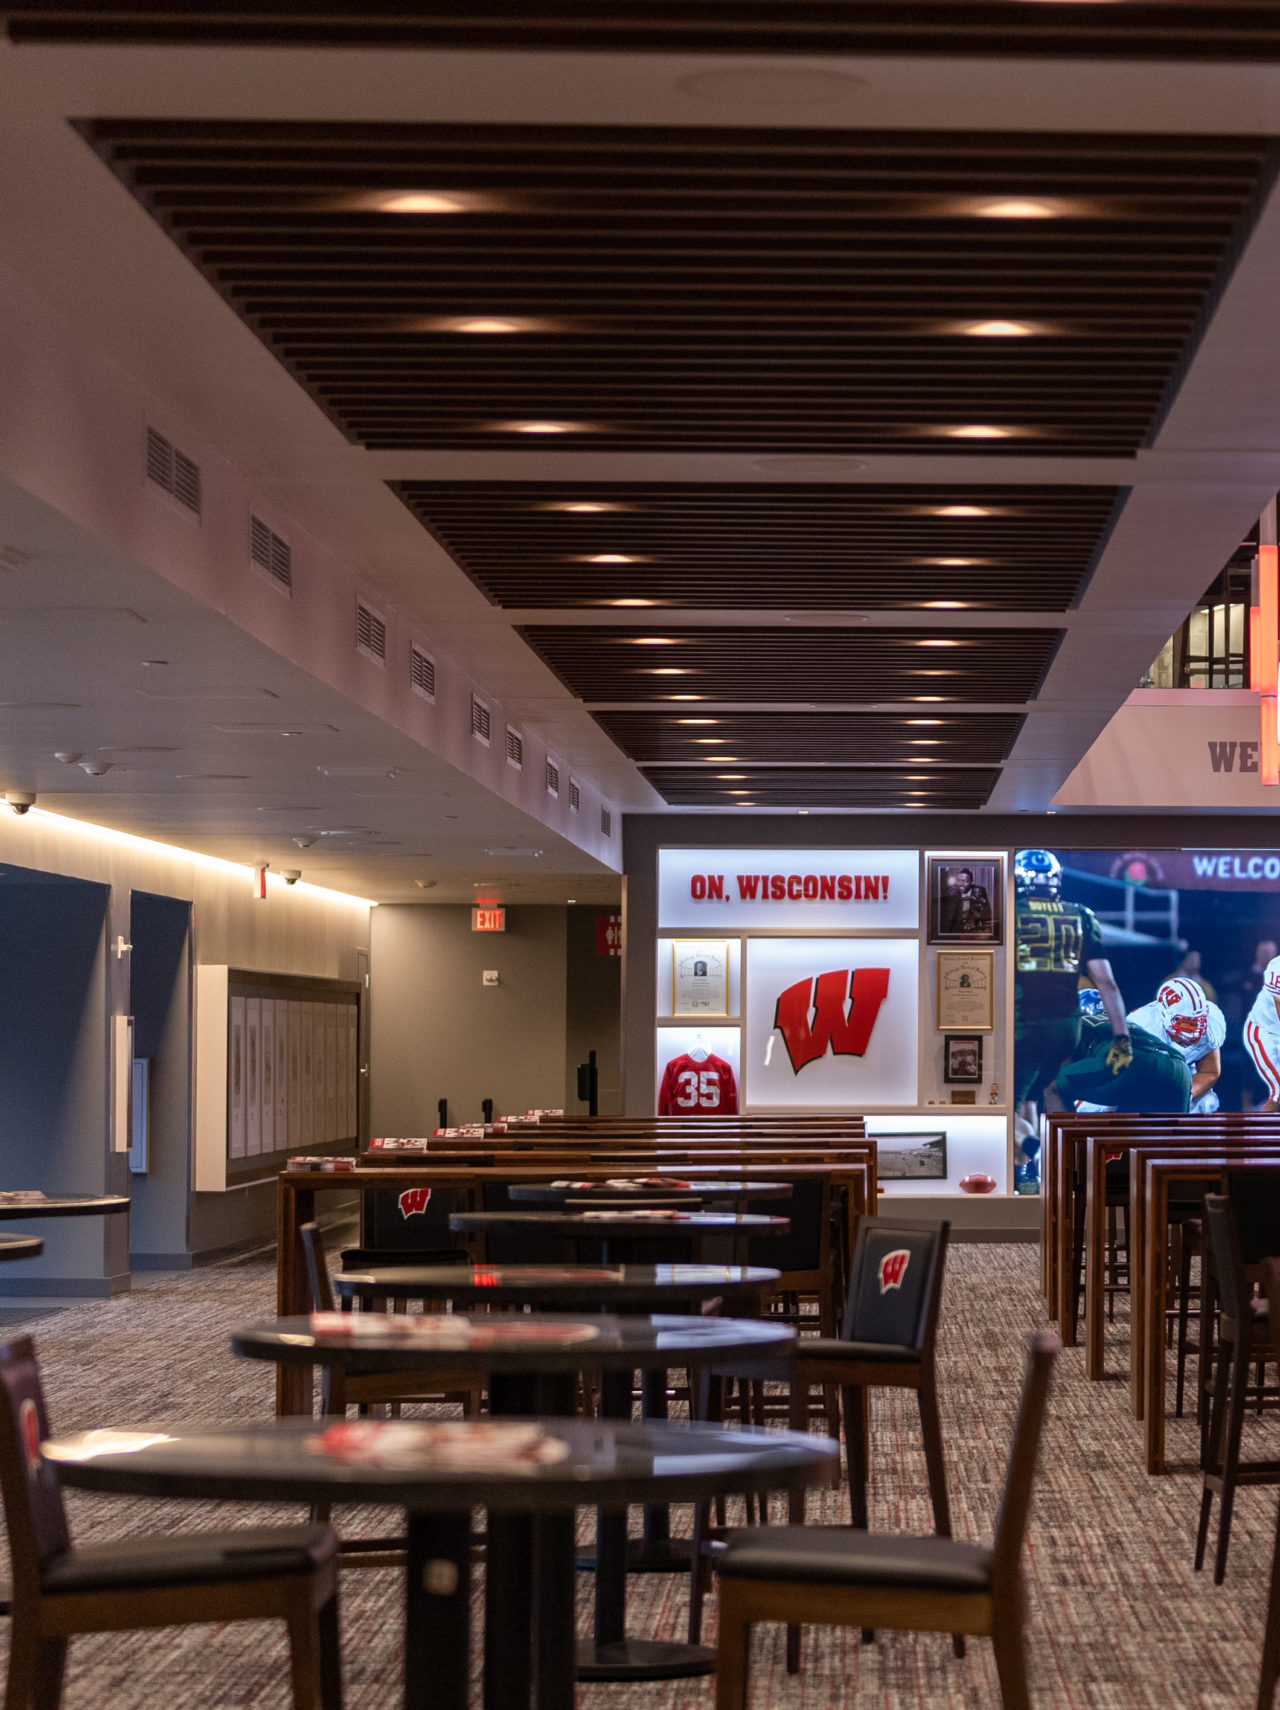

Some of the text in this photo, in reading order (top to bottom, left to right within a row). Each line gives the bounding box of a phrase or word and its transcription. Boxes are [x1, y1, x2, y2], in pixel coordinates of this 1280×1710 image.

[691, 874, 890, 903] ON, WISCONSIN!
[476, 910, 502, 929] EXIT
[1017, 913, 1083, 973] 20
[773, 968, 891, 1077] W
[677, 1071, 720, 1107] 35
